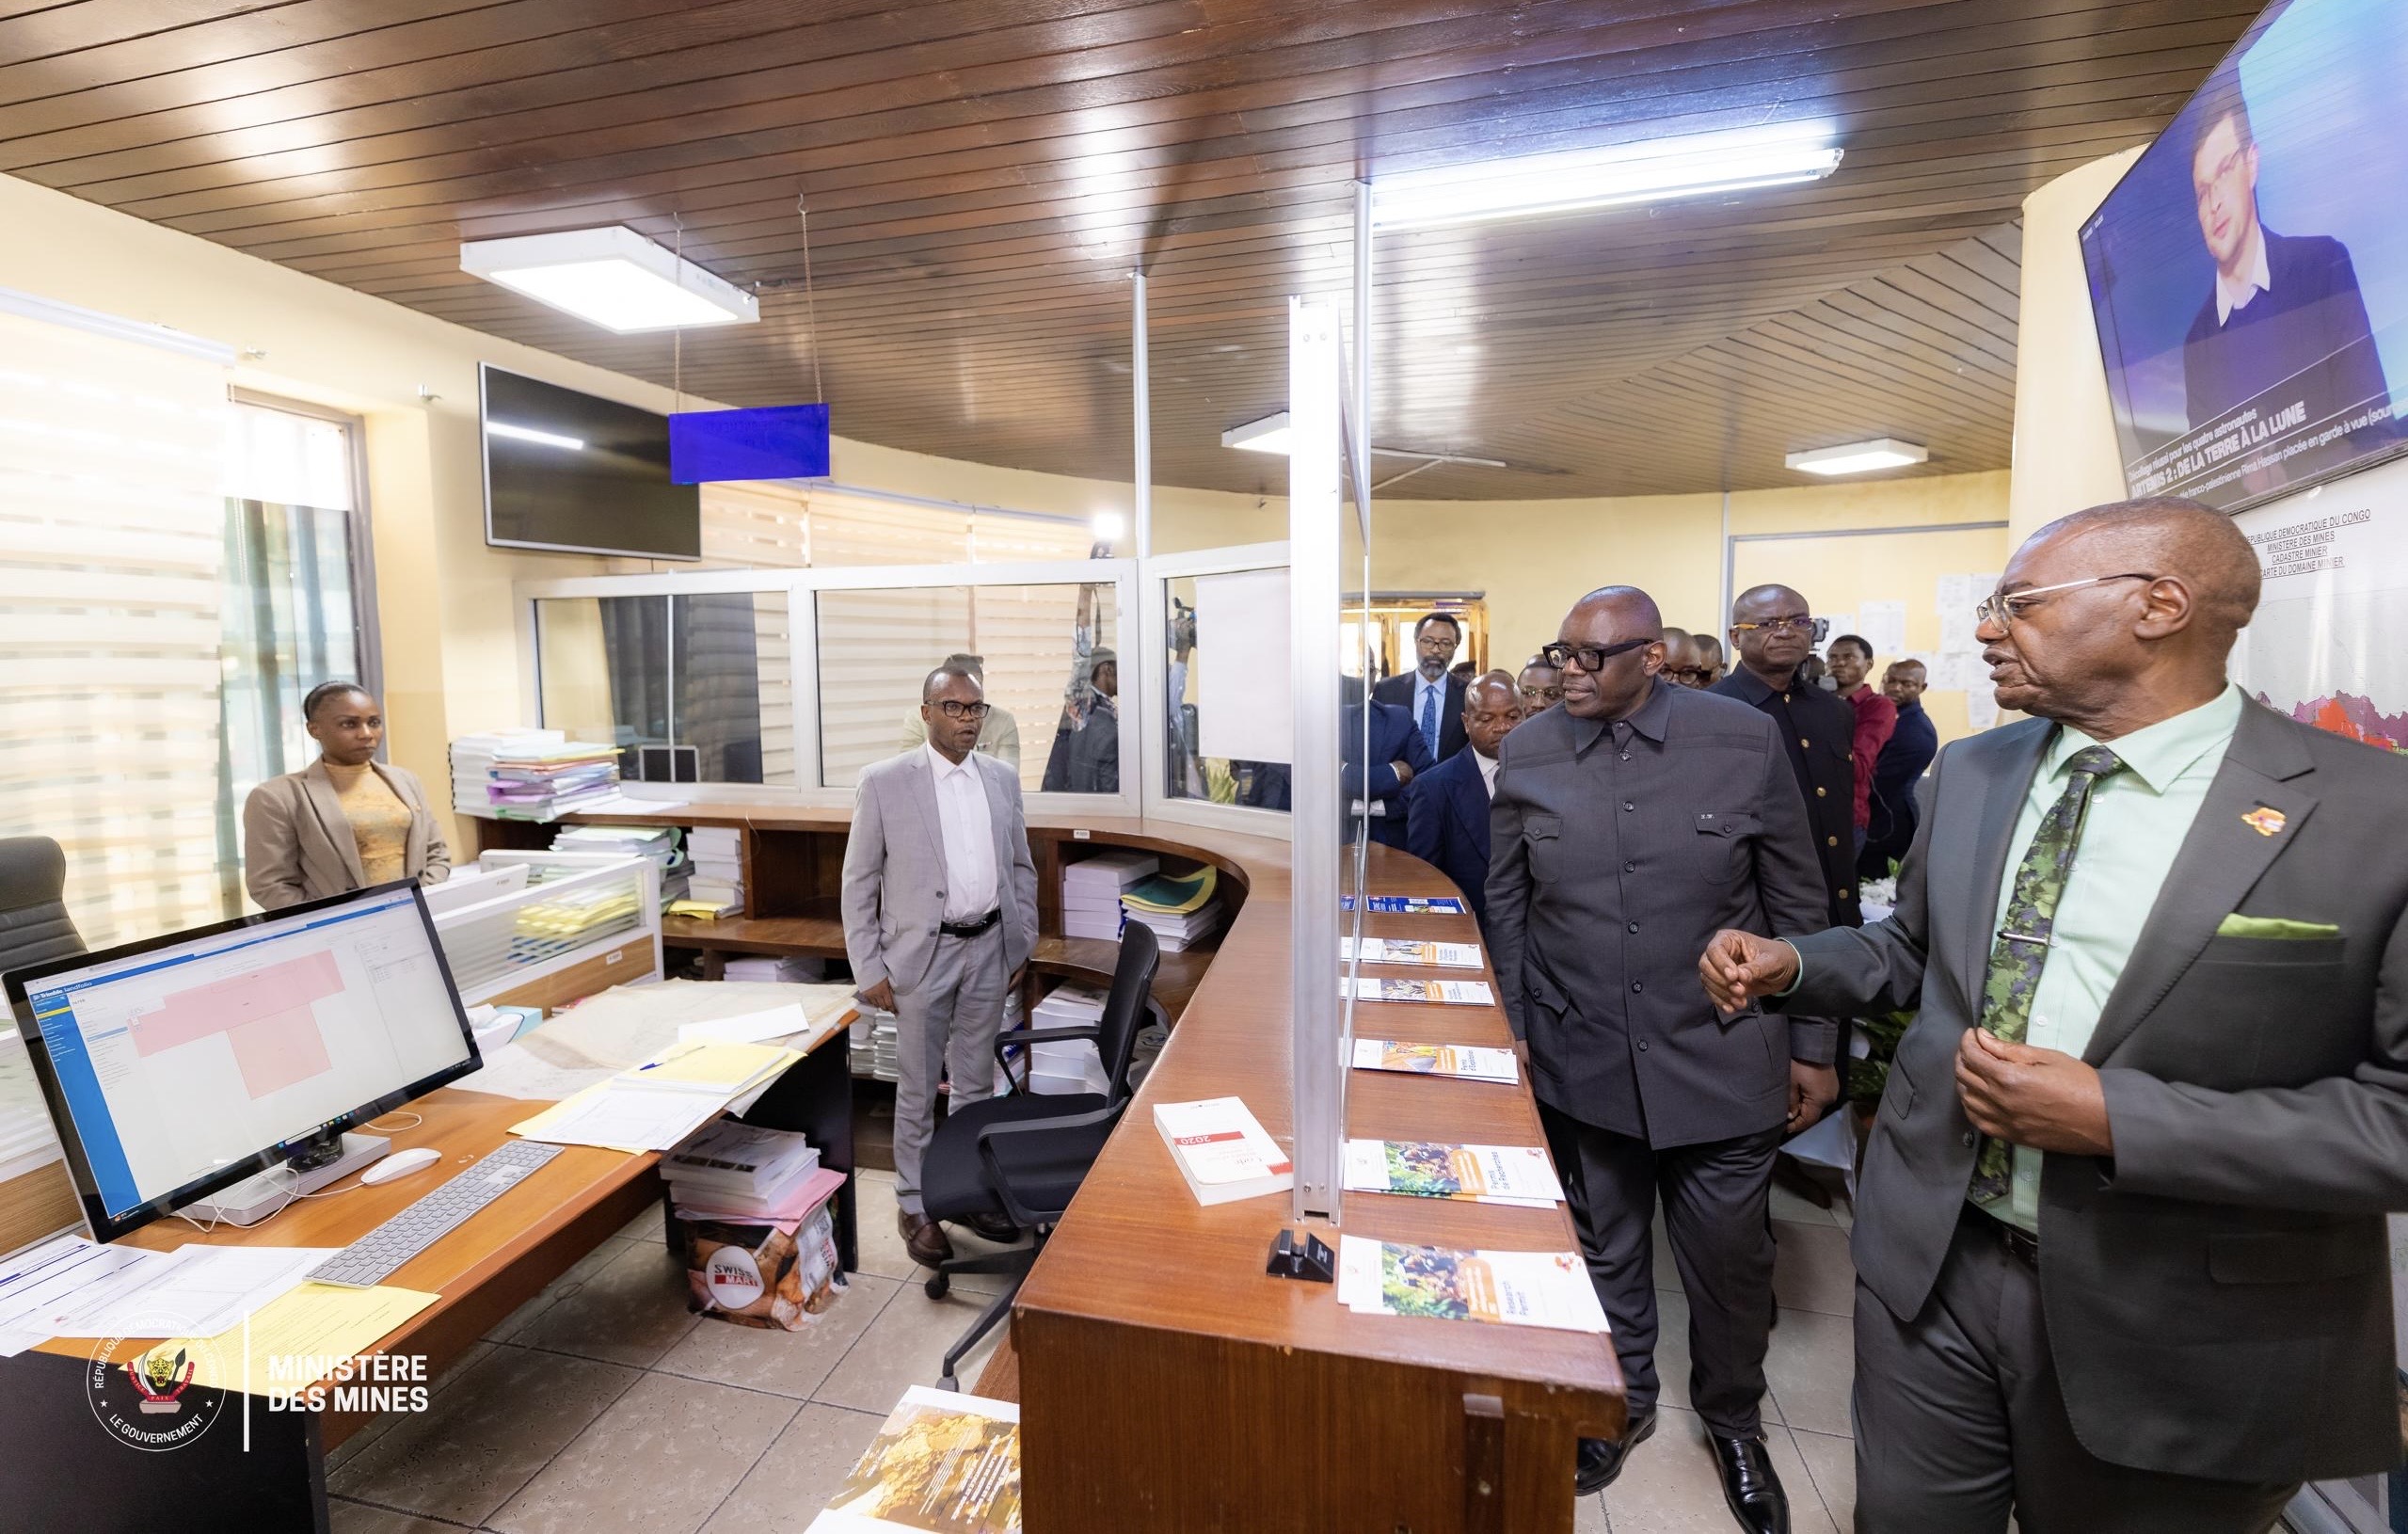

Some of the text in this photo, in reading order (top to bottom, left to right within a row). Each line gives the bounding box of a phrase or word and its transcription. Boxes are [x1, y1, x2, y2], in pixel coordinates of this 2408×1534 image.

[2169, 446, 2183, 464] pour
[2182, 441, 2193, 454] les
[2193, 431, 2214, 450] quatre
[2214, 408, 2257, 438] astronautes
[2241, 461, 2258, 476] Rima
[2257, 450, 2284, 470] Hassan
[2283, 439, 2308, 460] placée
[2307, 435, 2319, 449] en
[2318, 425, 2344, 447] garde
[2343, 420, 2352, 433] à
[2349, 415, 2368, 430] vue
[2131, 471, 2166, 499] ARTEMIS
[2166, 467, 2174, 484] 2
[2177, 458, 2192, 477] DE
[2190, 452, 2205, 471] LA
[2204, 434, 2241, 464] TERRE
[2241, 425, 2251, 448] À
[2251, 420, 2270, 443] LA
[2269, 401, 2306, 435] LUNE
[2278, 519, 2327, 538] DEMOCRATIQUE
[2329, 516, 2341, 526] DU
[2341, 508, 2371, 524] CONGO
[2268, 531, 2336, 552] MINISTERE DES MINES
[2272, 545, 2328, 564] CADASTRE MINIER
[2260, 567, 2278, 578] ARTE
[2278, 566, 2288, 576] DU
[2288, 560, 2316, 573] DOMAINE
[1180, 1135, 1211, 1145] 2020
[714, 1264, 753, 1278] SWISS
[726, 1274, 758, 1286] MART
